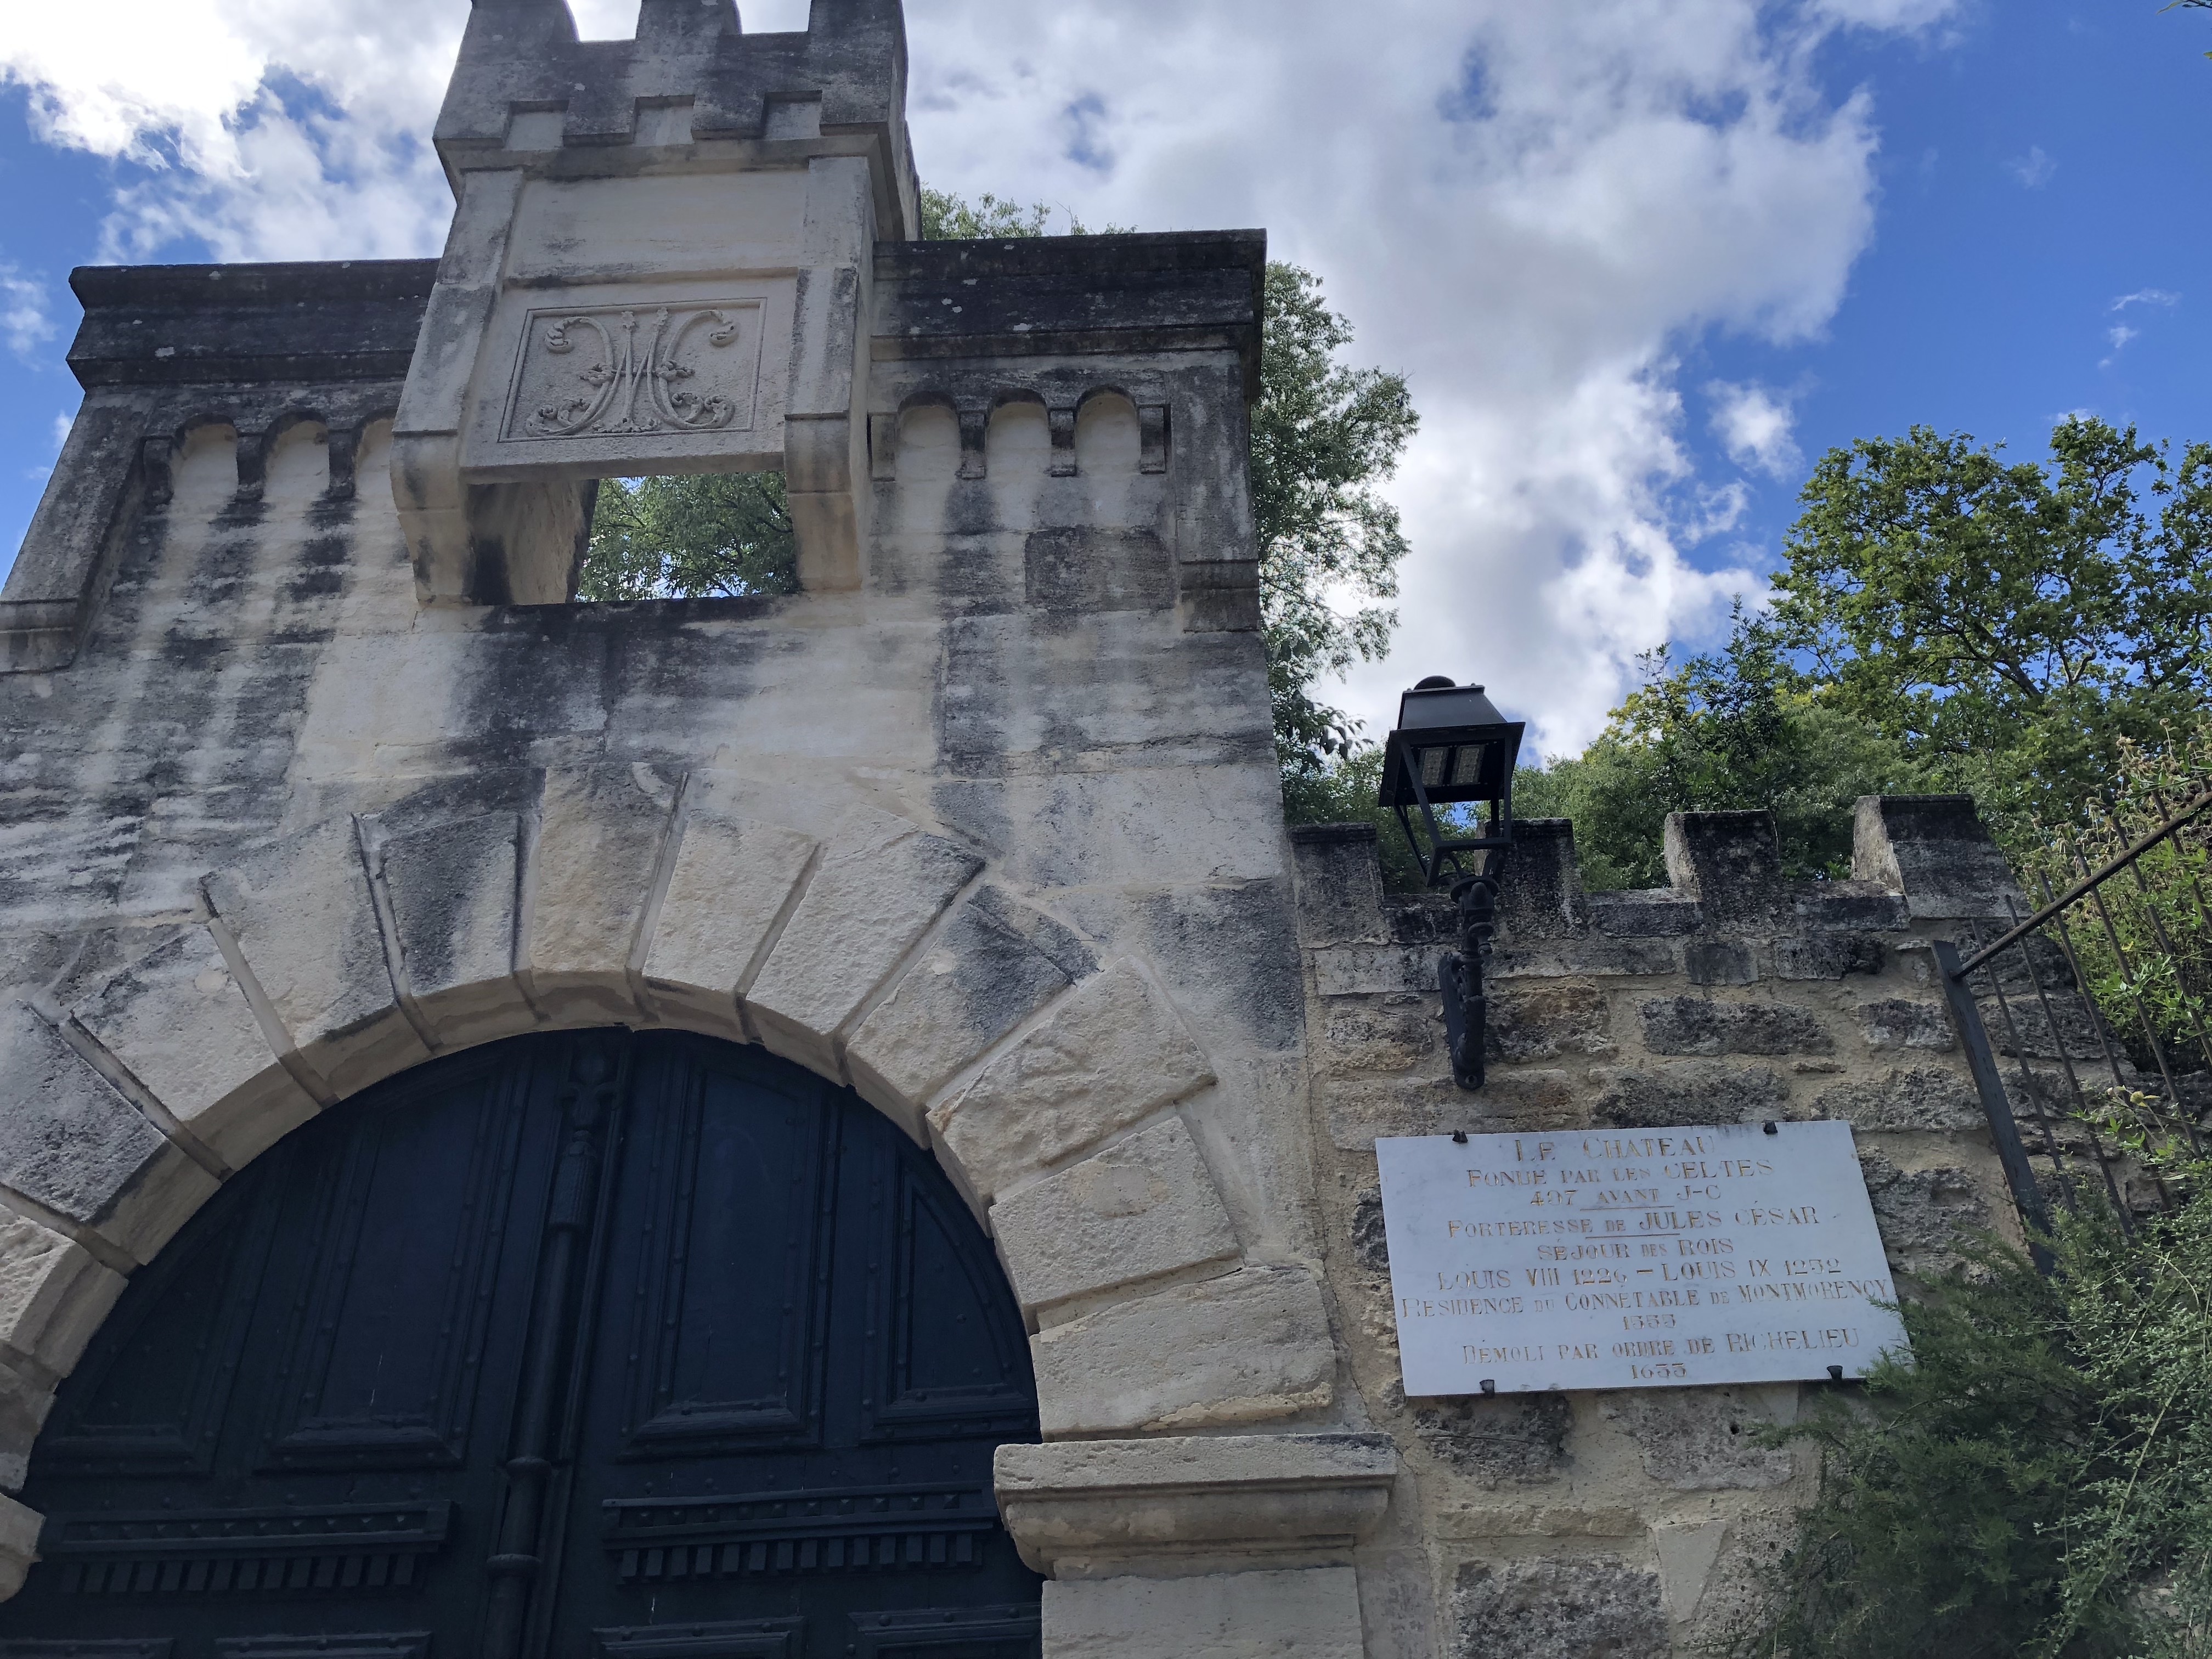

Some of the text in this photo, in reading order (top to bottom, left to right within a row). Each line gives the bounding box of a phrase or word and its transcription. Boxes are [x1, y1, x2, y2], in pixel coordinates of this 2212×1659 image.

[1515, 1135, 1714, 1161] LE CHATEAU
[1561, 1169, 1601, 1184] PAR
[1613, 1168, 1651, 1181] LES
[1664, 1159, 1773, 1179] CELTES
[1597, 1188, 1659, 1205] AVANT
[1448, 1218, 1593, 1238] FORTERESSE
[1605, 1220, 1626, 1232] DE
[1639, 1210, 1722, 1229] JULES
[1641, 1243, 1667, 1257] DES
[1678, 1238, 1734, 1256] ROIS
[1438, 1269, 1511, 1290] LOUIS
[1526, 1268, 1560, 1286] VIII
[1573, 1268, 1627, 1285] 1226
[1661, 1261, 1736, 1282] LOUIS
[1749, 1259, 1771, 1278] IX
[1534, 1299, 1555, 1312] DU
[1710, 1291, 1730, 1304] DE
[1737, 1279, 1887, 1303] MONTMORENCY
[1559, 1344, 1598, 1359] PAR
[1612, 1340, 1674, 1357] ORDRE
[1725, 1328, 1859, 1353] RICHELIEU
